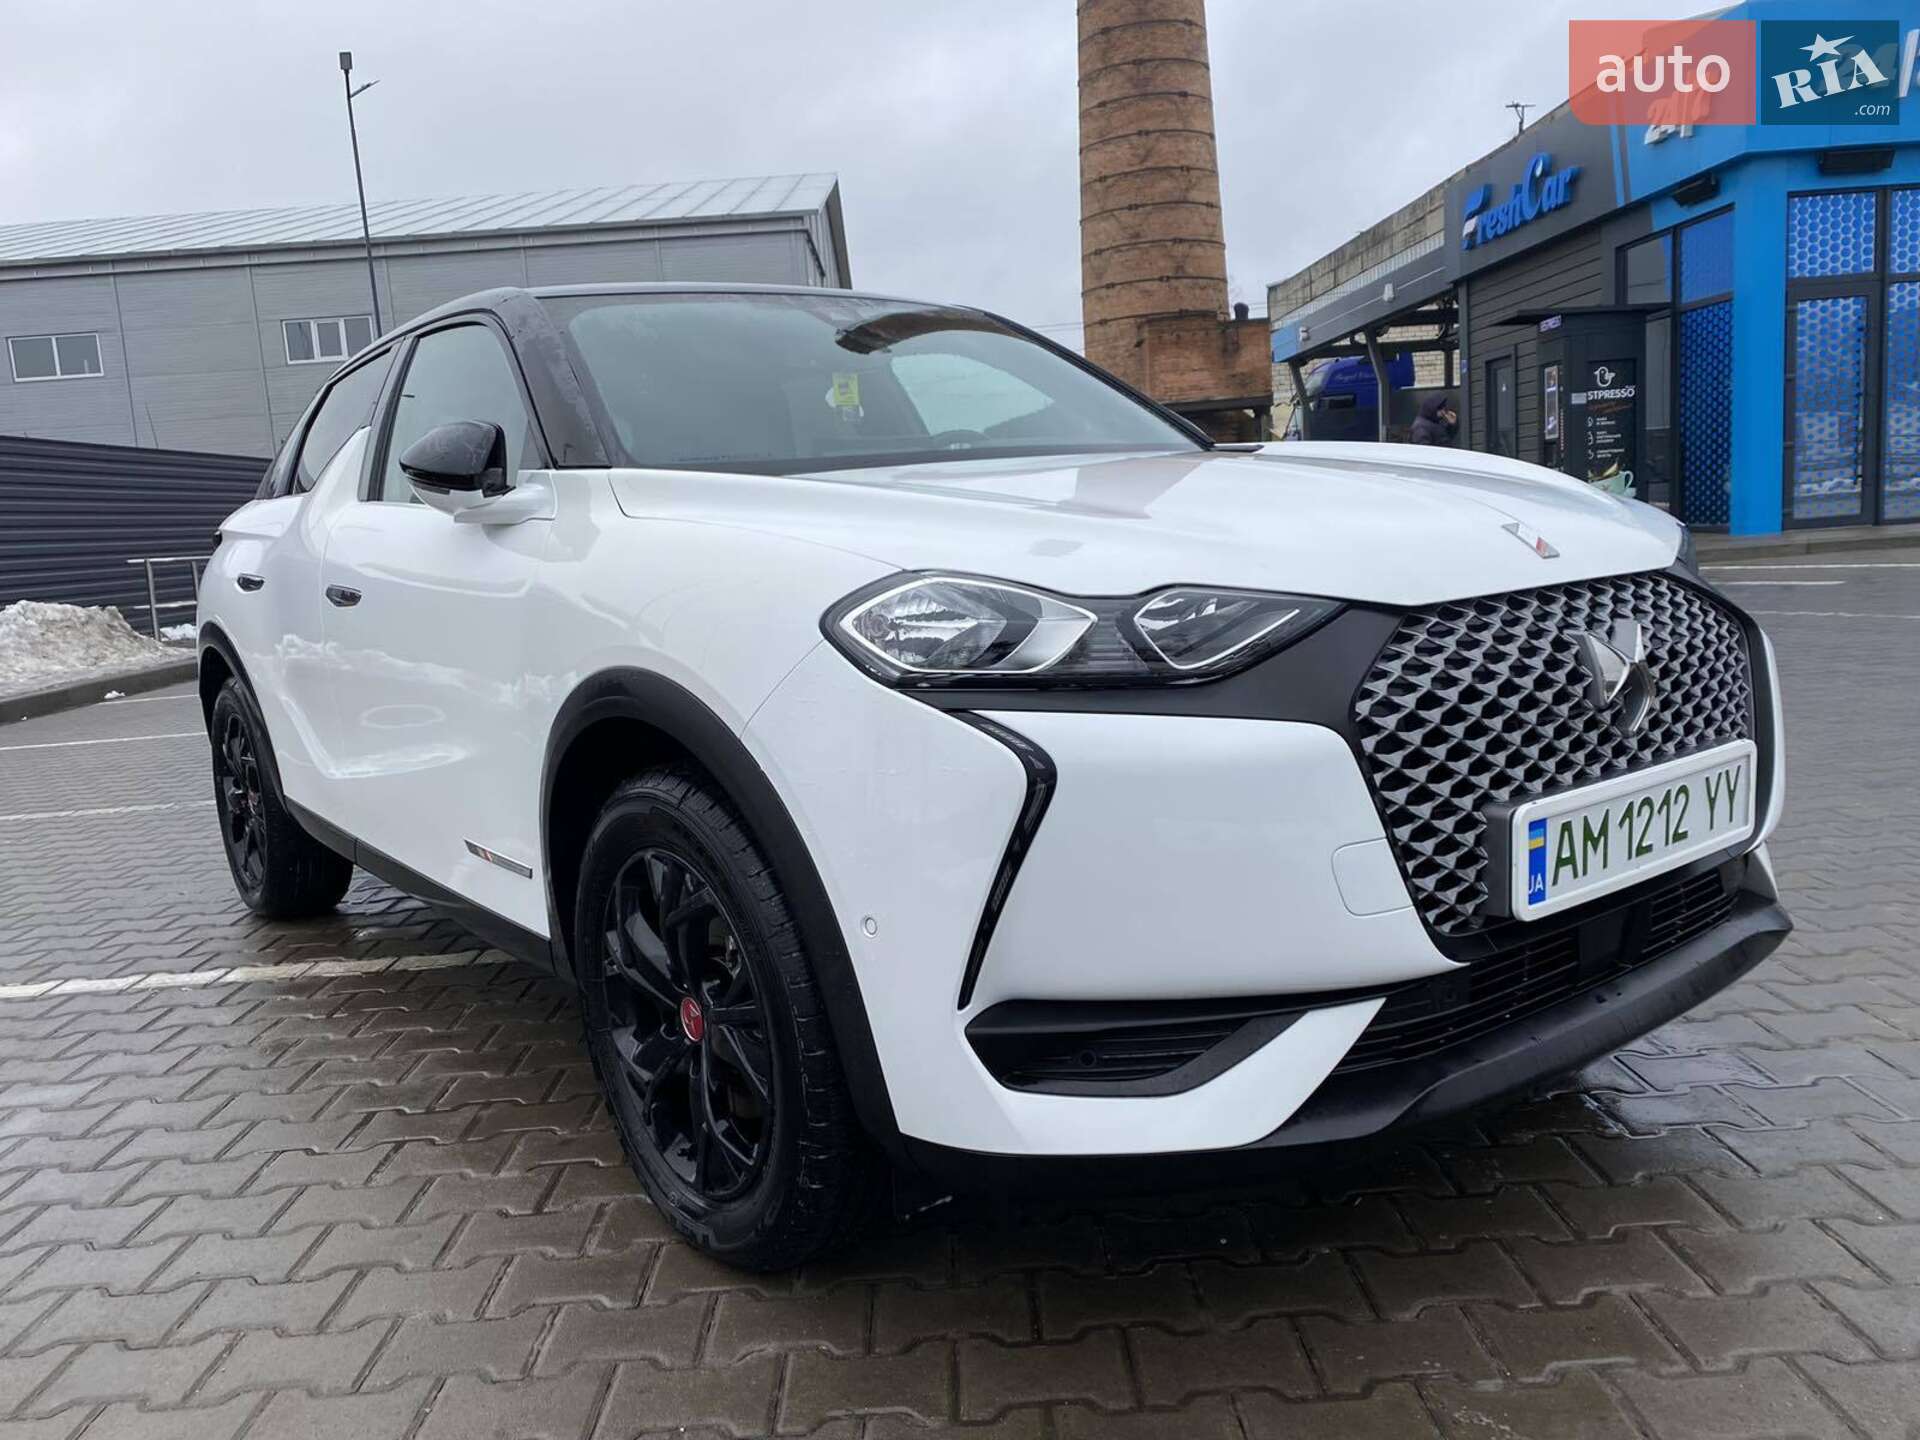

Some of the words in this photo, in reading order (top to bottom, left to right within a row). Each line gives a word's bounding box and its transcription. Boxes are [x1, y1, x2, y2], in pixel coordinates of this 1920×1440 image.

[1462, 152, 1583, 250] FreshCar
[1552, 808, 1610, 886] AM
[1618, 784, 1689, 860] 1212
[1705, 765, 1742, 830] YY
